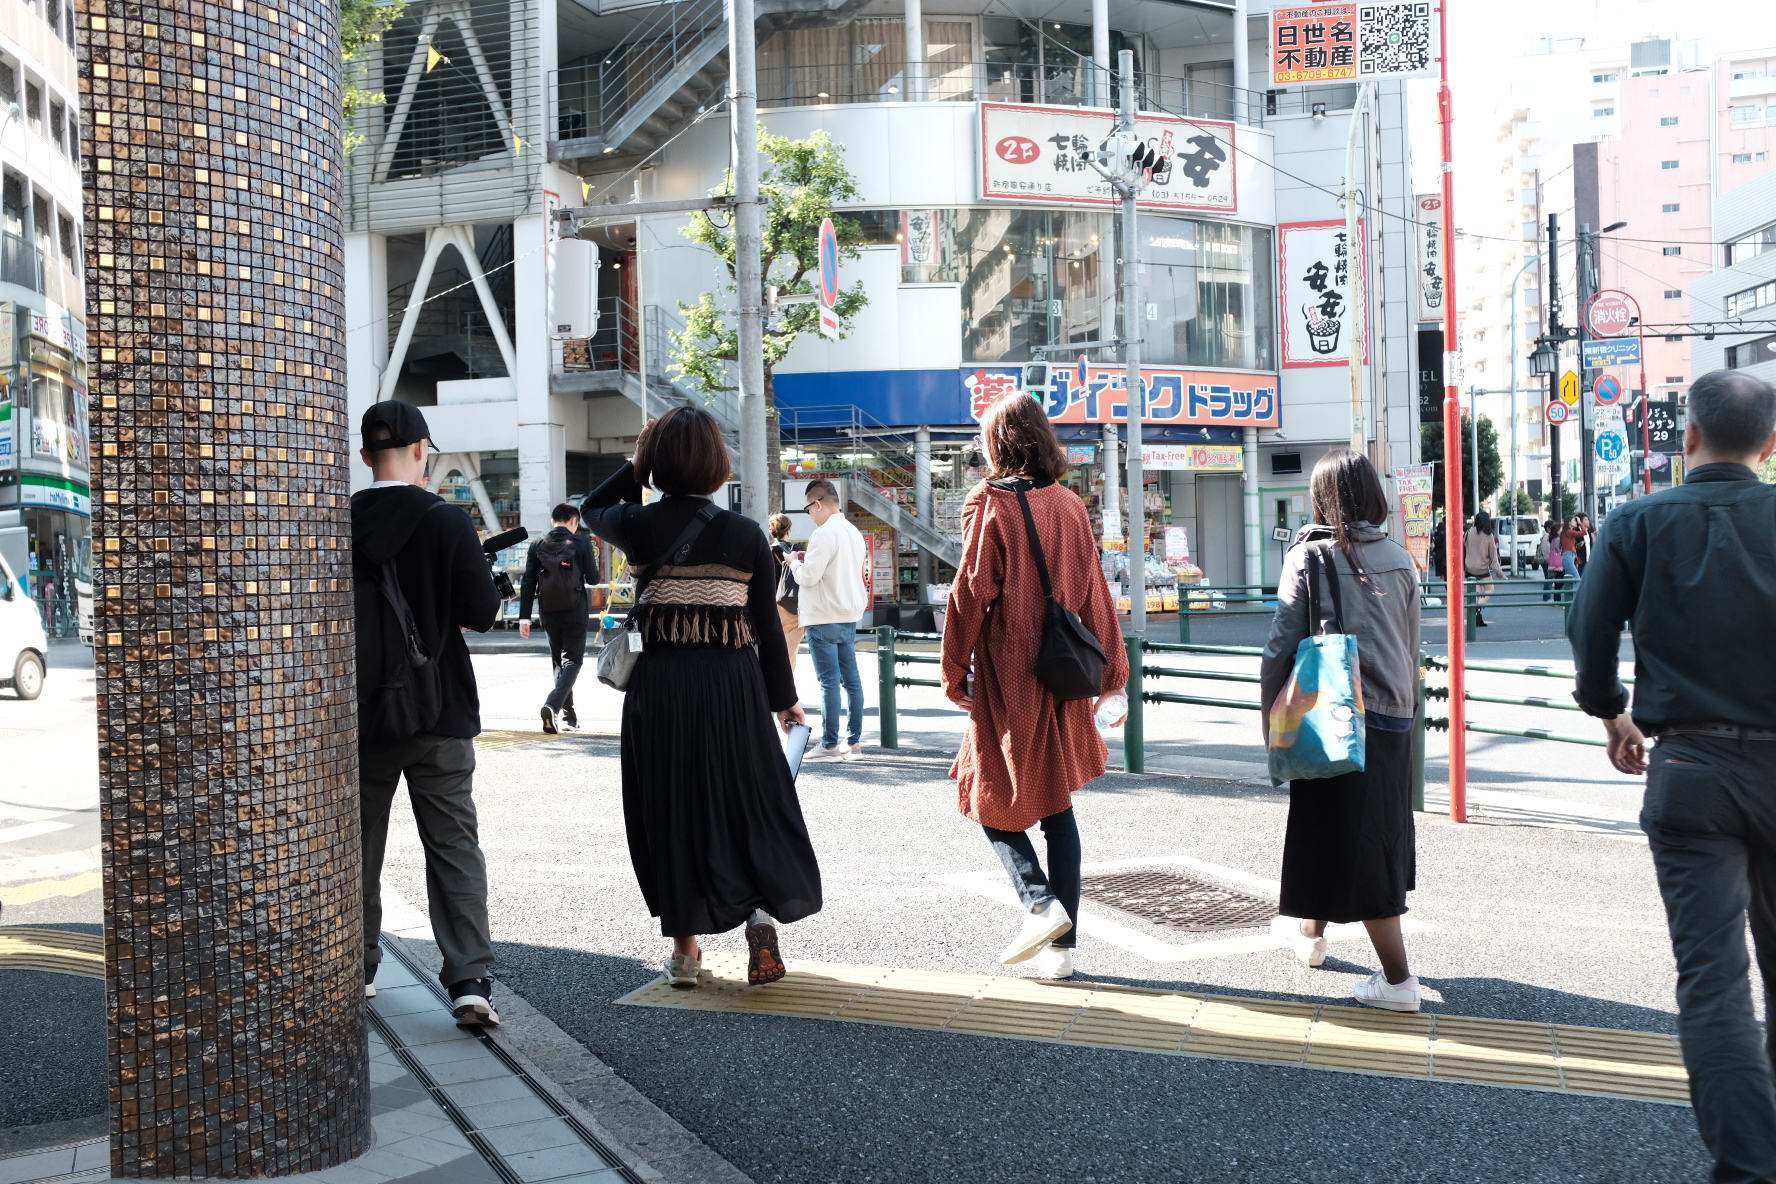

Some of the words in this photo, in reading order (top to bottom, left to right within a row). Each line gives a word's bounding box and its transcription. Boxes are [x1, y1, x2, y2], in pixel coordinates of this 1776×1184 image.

[1278, 21, 1353, 46] 日世名
[1278, 45, 1354, 70] 不動産
[1278, 68, 1353, 82] 03-6709-6747
[1002, 140, 1033, 160] 2F
[1048, 132, 1089, 152] 七輪
[992, 180, 1052, 192] 新宿職安通り店
[1152, 190, 1168, 199] (03)
[1424, 200, 1440, 210] 2F
[1426, 221, 1437, 258] 七輪焼肉
[1334, 232, 1348, 286] 七輪焼肉
[1302, 260, 1343, 319] 安安
[1148, 305, 1155, 318] 4
[1594, 308, 1627, 324] 消火栓
[1585, 343, 1638, 355] 東新宿クリニック
[1419, 371, 1438, 381] EL
[1188, 382, 1275, 421] ドラッグ
[1551, 407, 1564, 418] 50
[1653, 431, 1668, 441] 29
[1152, 451, 1185, 460] Tax-Free
[1602, 439, 1612, 458] P
[1406, 521, 1430, 538] OFF
